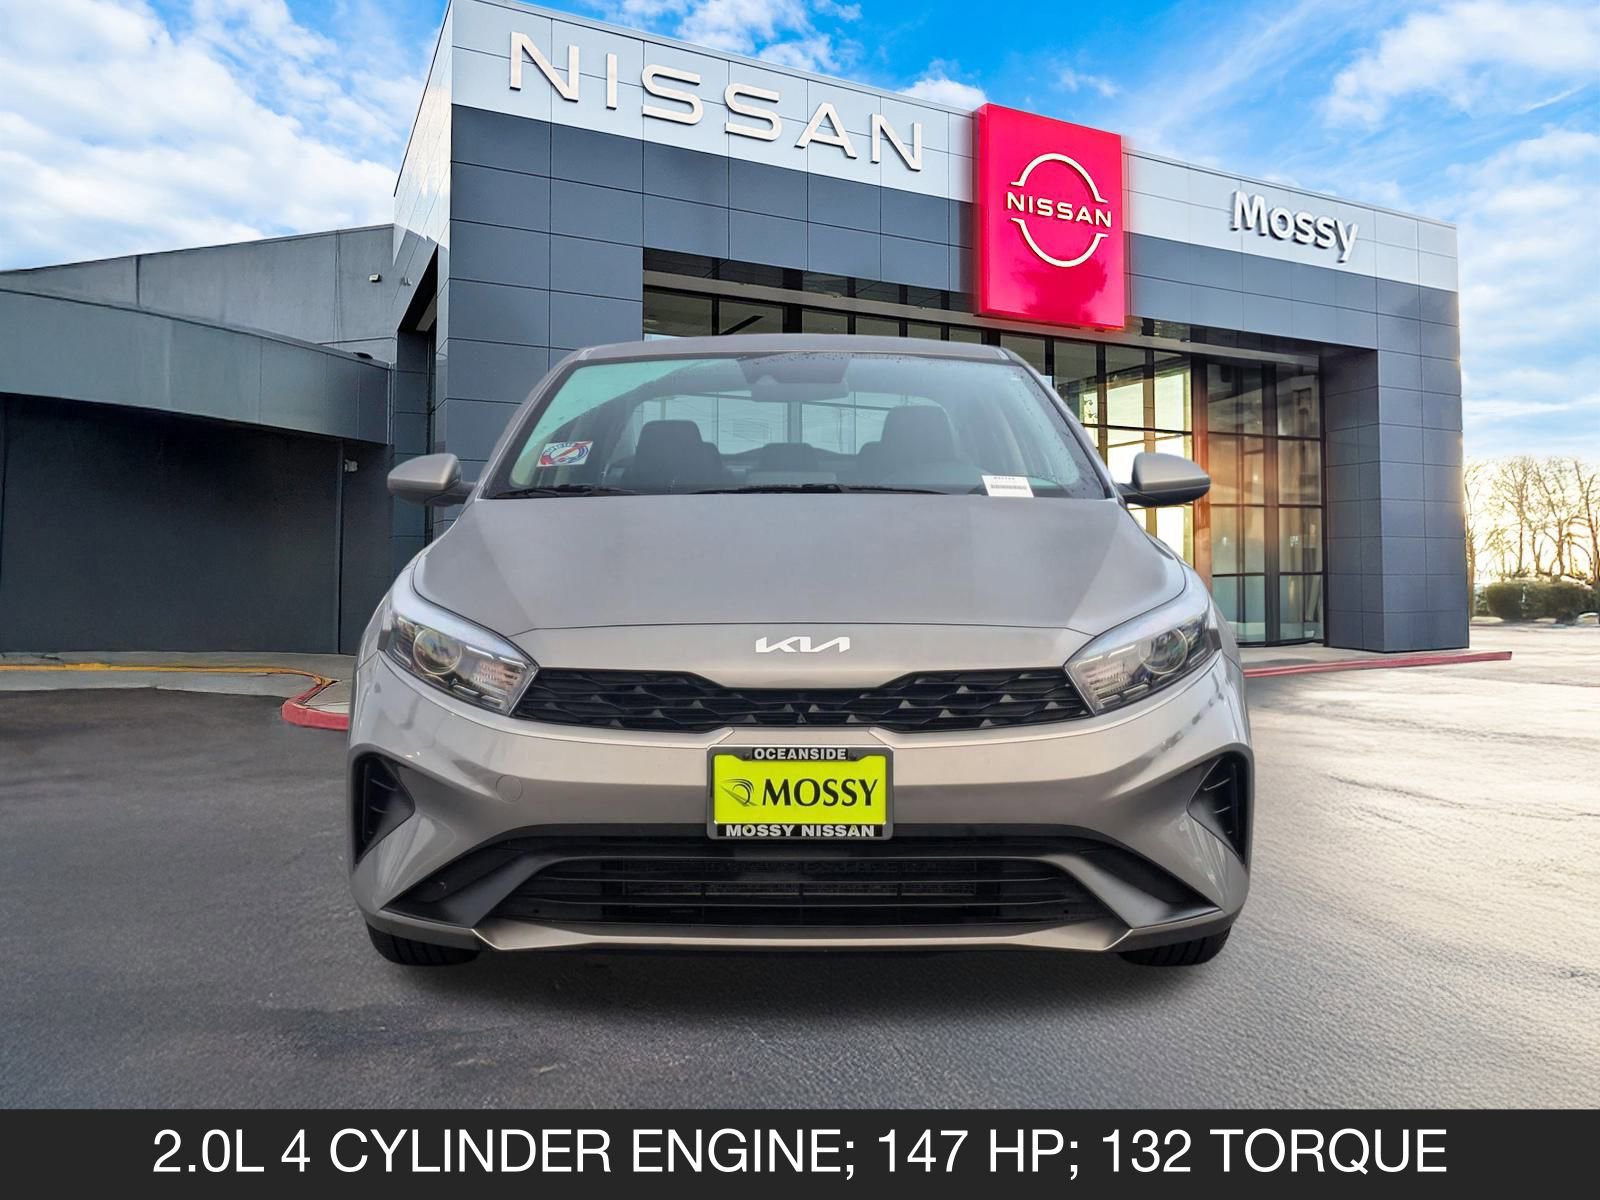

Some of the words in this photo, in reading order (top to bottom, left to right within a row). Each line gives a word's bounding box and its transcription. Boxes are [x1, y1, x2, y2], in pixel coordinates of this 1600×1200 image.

[509, 31, 922, 171] NISSAN
[1007, 191, 1112, 228] NISSAN
[1231, 190, 1358, 262] Mossy
[754, 748, 847, 760] OCEANSIDE
[762, 778, 878, 807] MOSSY
[726, 824, 795, 837] MOSSY
[801, 824, 875, 837] NISSAN
